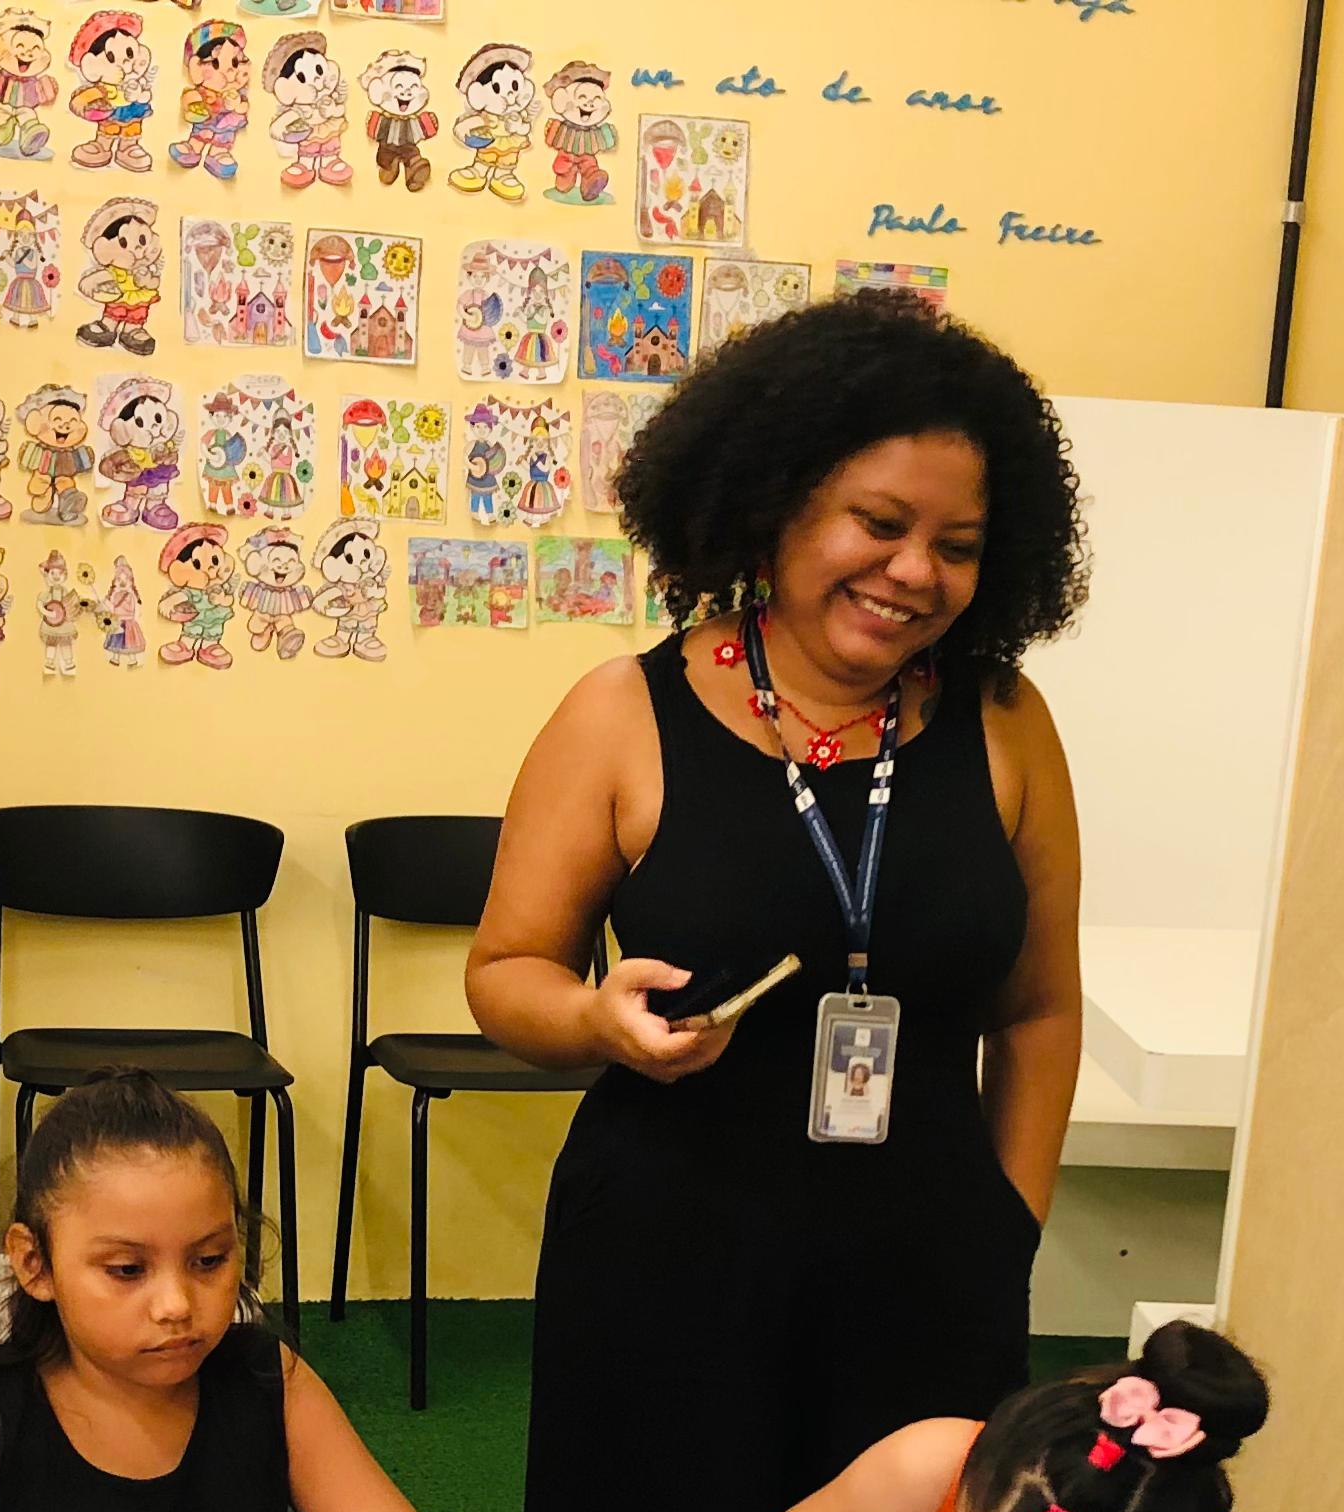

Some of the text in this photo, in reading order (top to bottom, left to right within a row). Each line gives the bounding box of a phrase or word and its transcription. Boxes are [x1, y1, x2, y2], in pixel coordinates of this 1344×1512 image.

[716, 65, 786, 97] ato
[822, 70, 871, 103] de
[906, 90, 1002, 114] amor
[868, 203, 1103, 245] Paulo Freire
